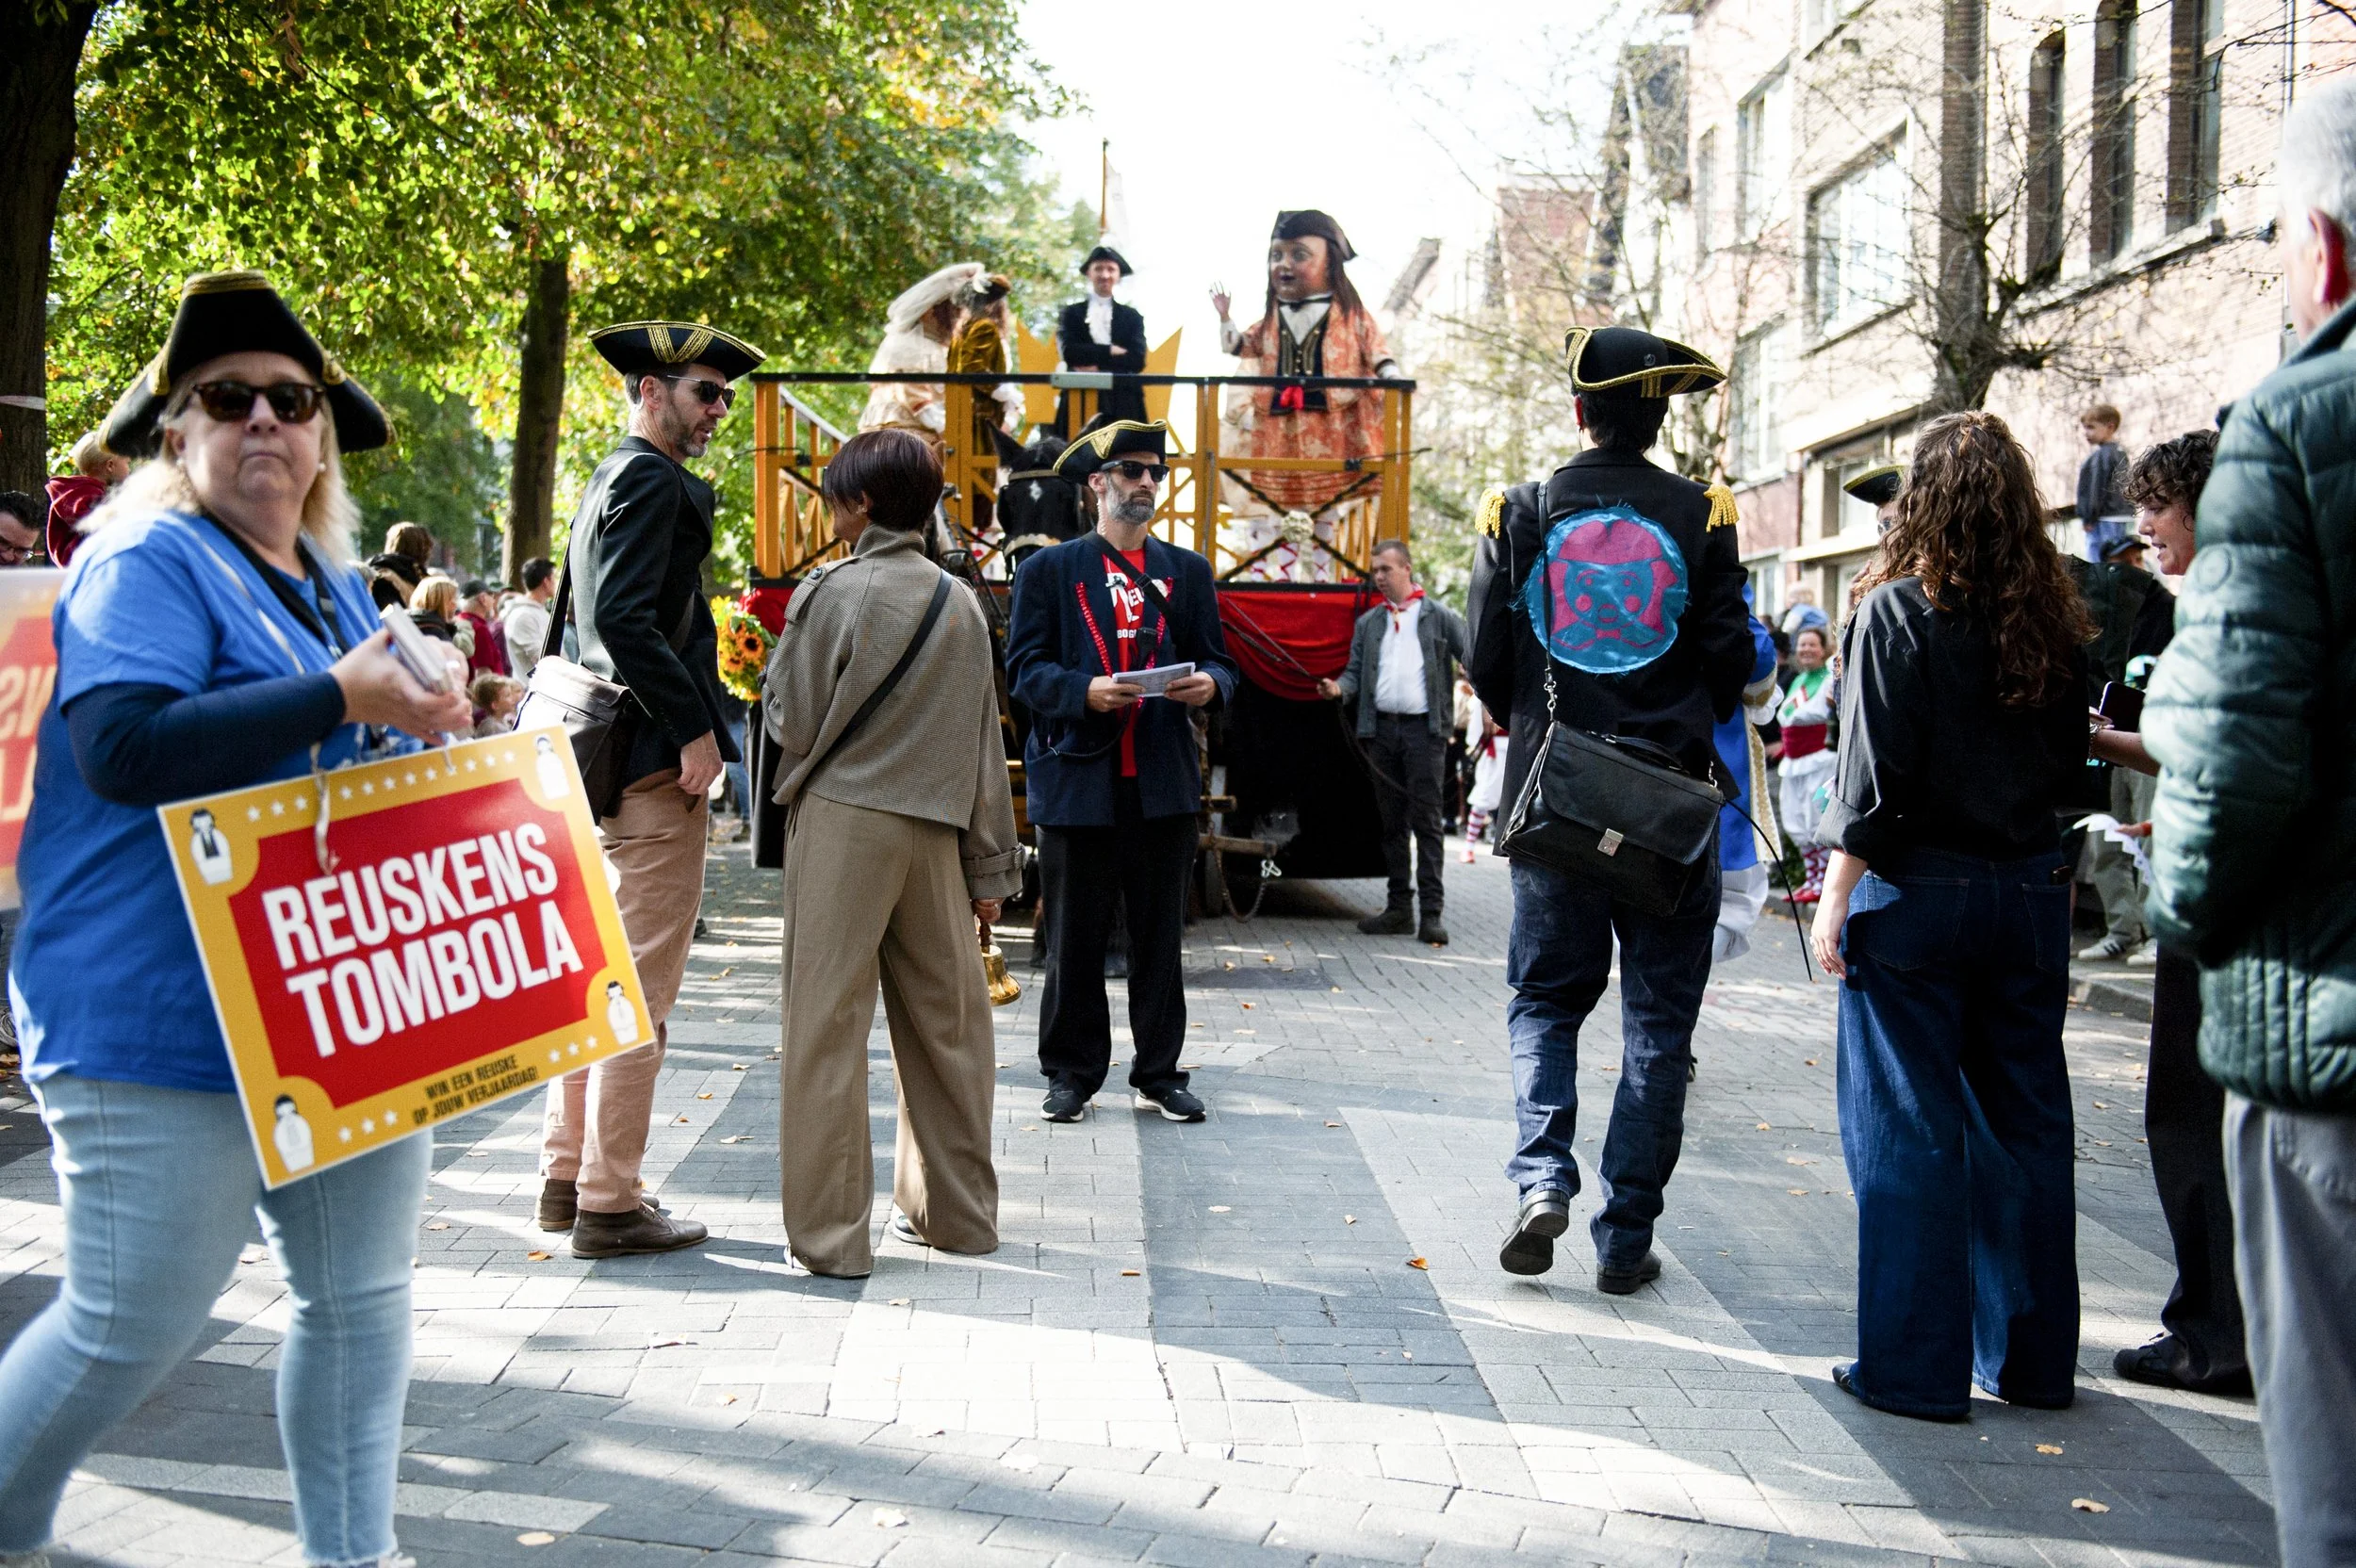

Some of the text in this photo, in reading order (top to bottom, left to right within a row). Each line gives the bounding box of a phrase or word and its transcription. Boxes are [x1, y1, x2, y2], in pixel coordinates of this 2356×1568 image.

[1117, 629, 1137, 639] BOG
[262, 823, 559, 971] REUSKENS
[286, 900, 583, 1058] TOMBOLA
[425, 1054, 517, 1100] WIN EEN REUSKE
[413, 1106, 428, 1124] OP
[433, 1093, 465, 1119] JOUW
